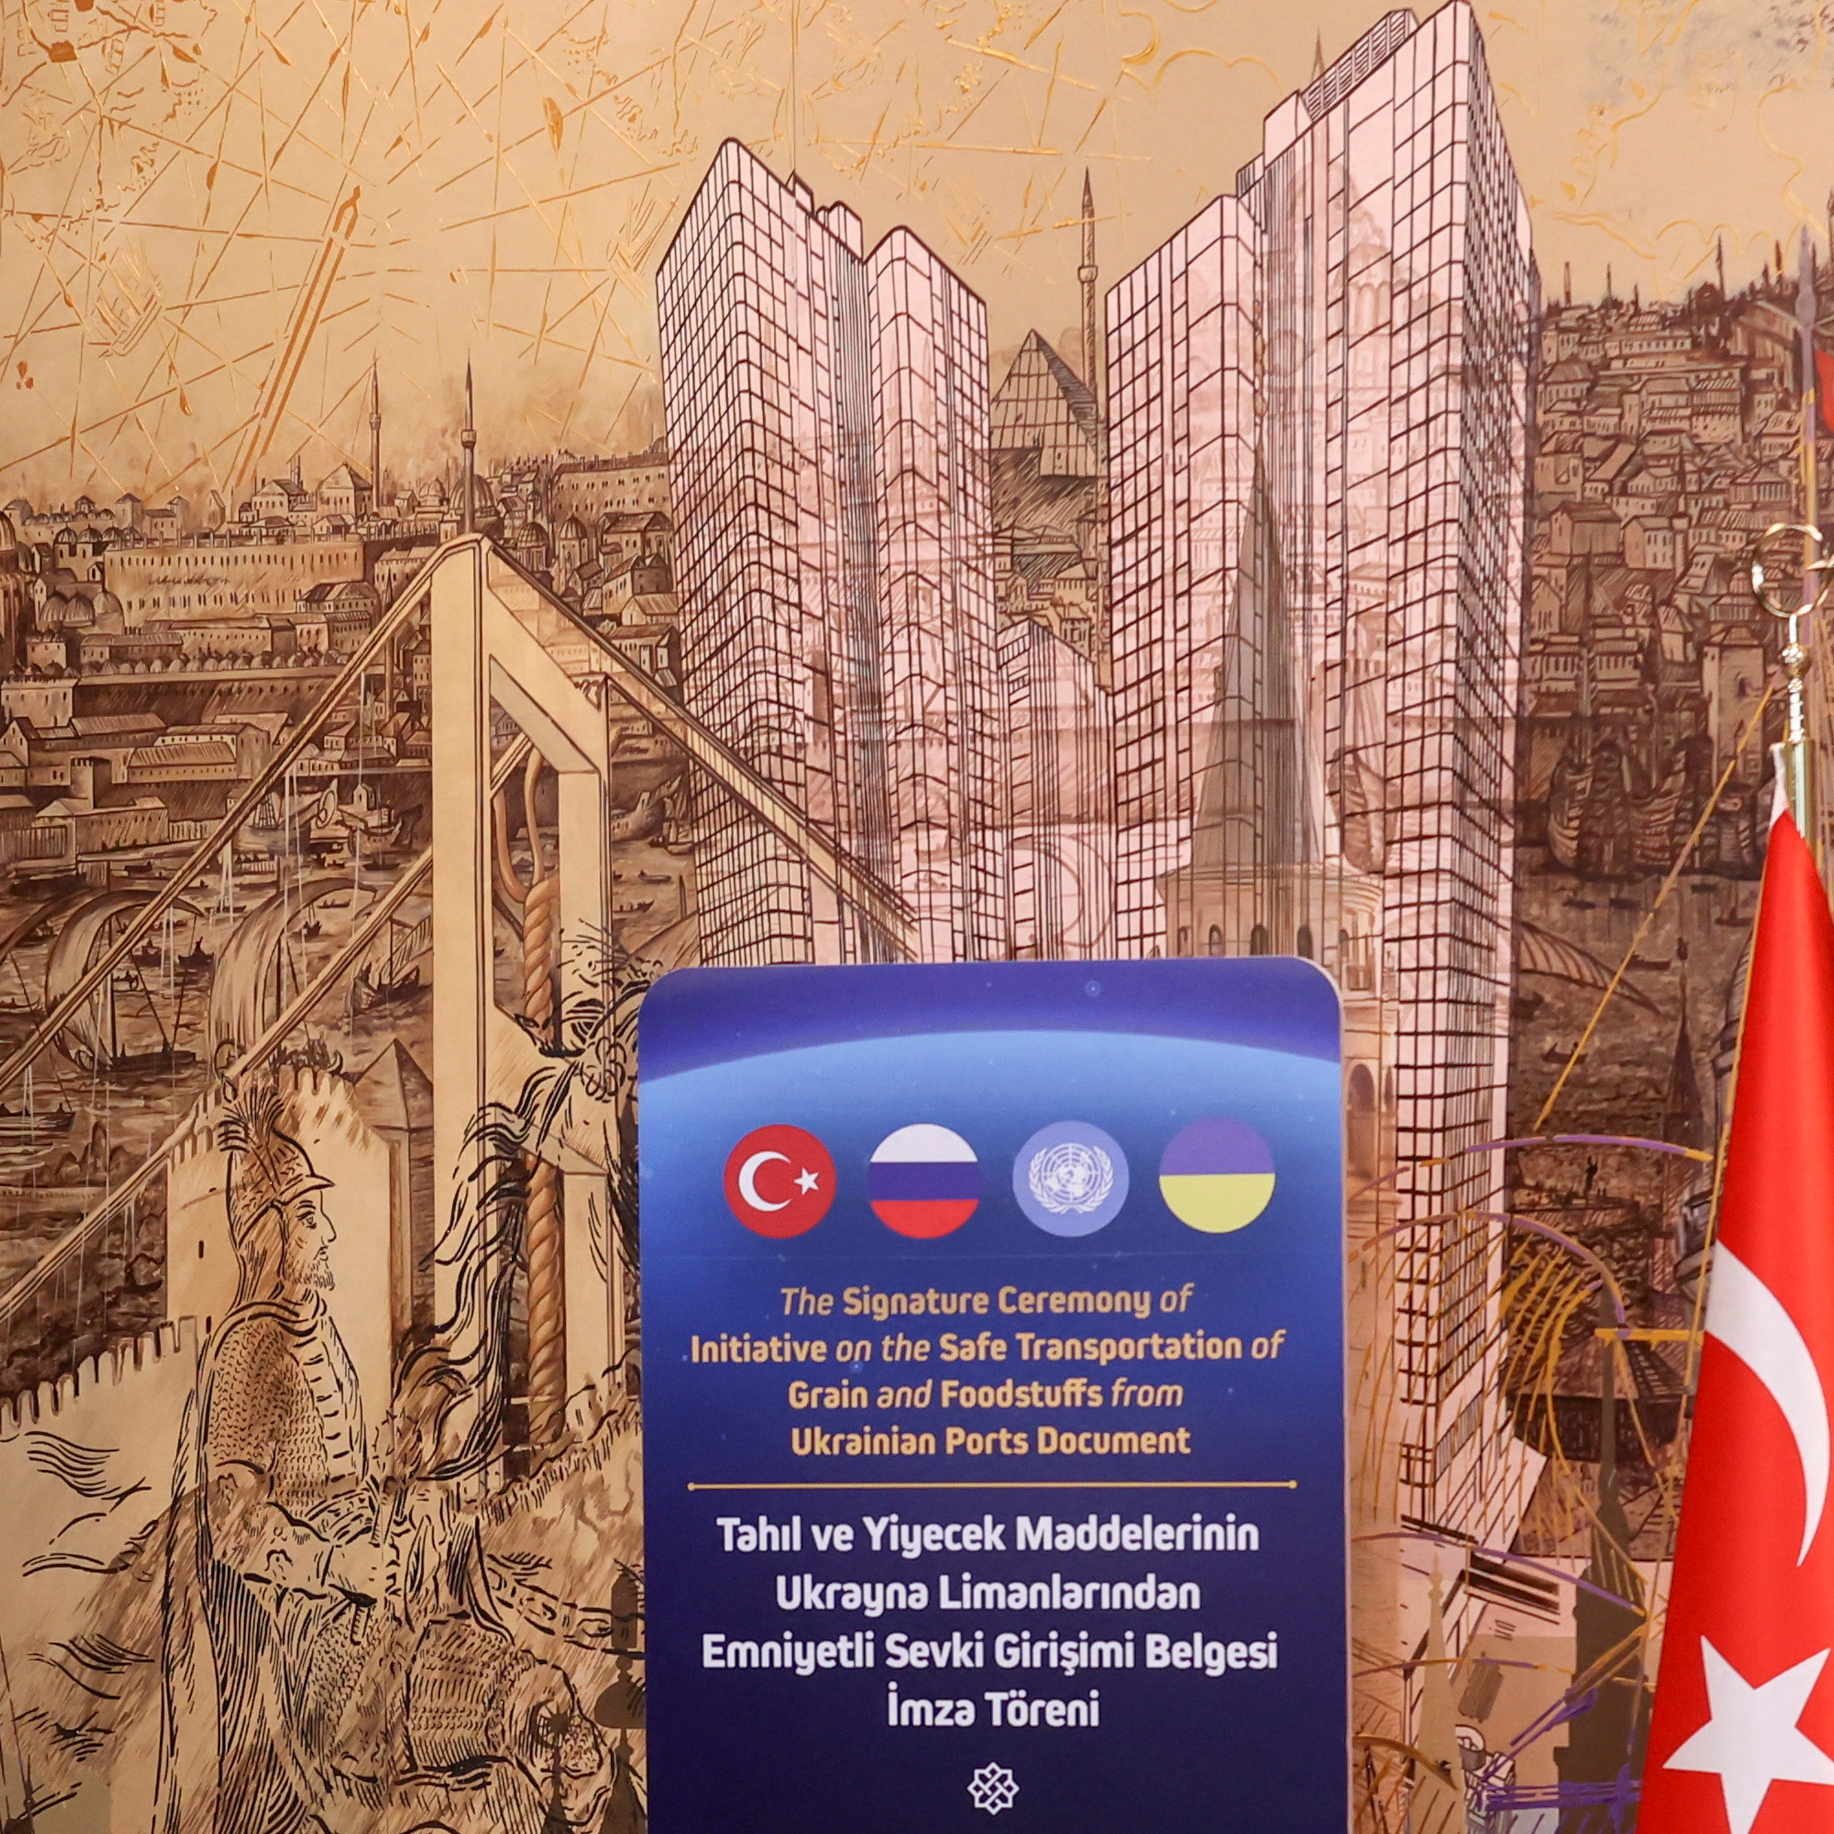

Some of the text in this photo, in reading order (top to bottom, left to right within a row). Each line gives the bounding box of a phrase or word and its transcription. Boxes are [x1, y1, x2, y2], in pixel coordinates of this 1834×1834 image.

[780, 1282, 1195, 1322] The Signature Ceremony of
[691, 1328, 1288, 1367] Initiative on the Safe Transportation of
[788, 1376, 1184, 1410] Grain and Foodstuffs from
[791, 1424, 1192, 1456] Ukrainian Ports Document
[716, 1512, 1259, 1560] Tahıl ve Yiyecek Maddelerinin
[776, 1571, 1201, 1618] Ukrayna Limanlarından
[702, 1630, 1278, 1677] Emniyetli Sevki Girişimi Belgesi
[888, 1681, 1099, 1727] İmza Töreni
